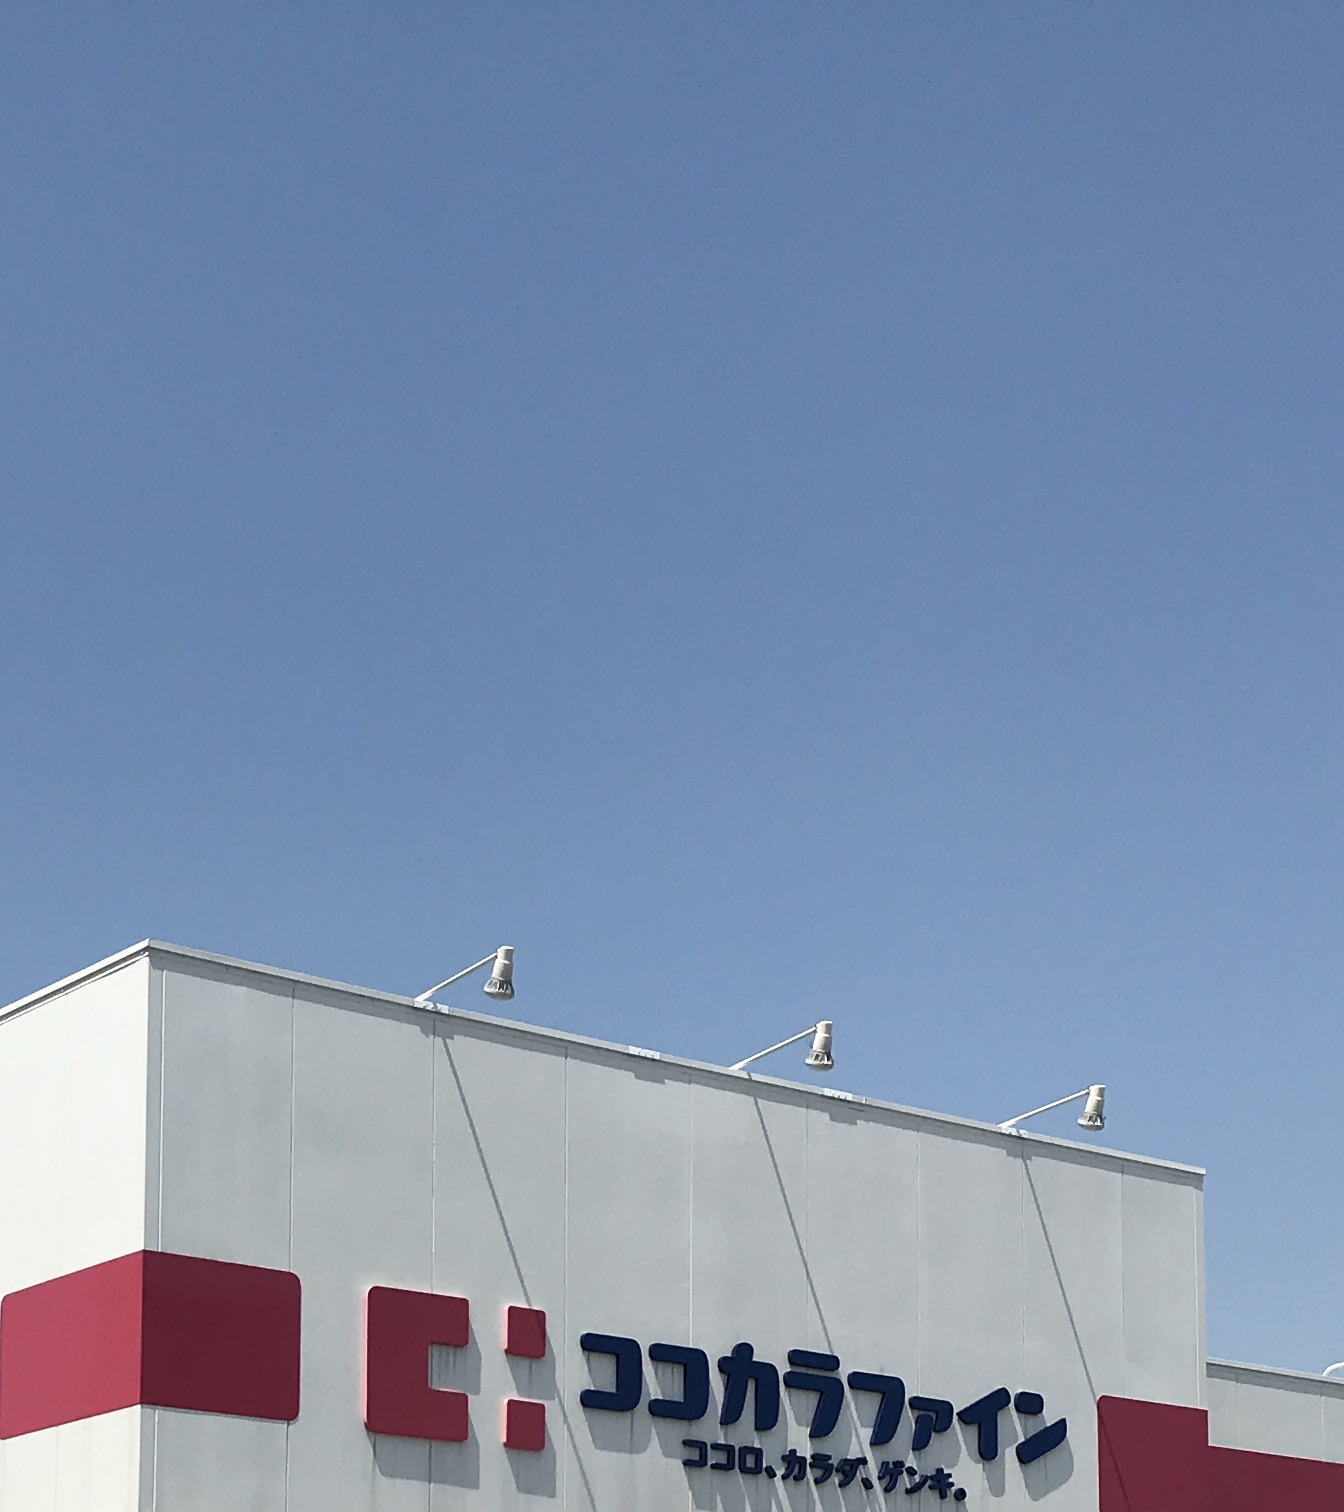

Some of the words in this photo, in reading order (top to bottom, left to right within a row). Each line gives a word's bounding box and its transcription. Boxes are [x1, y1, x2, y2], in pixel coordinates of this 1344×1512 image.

[579, 1332, 1067, 1465] ココカラファイン
[682, 1439, 967, 1502] ココロ、カラダ、ゲンキ。
